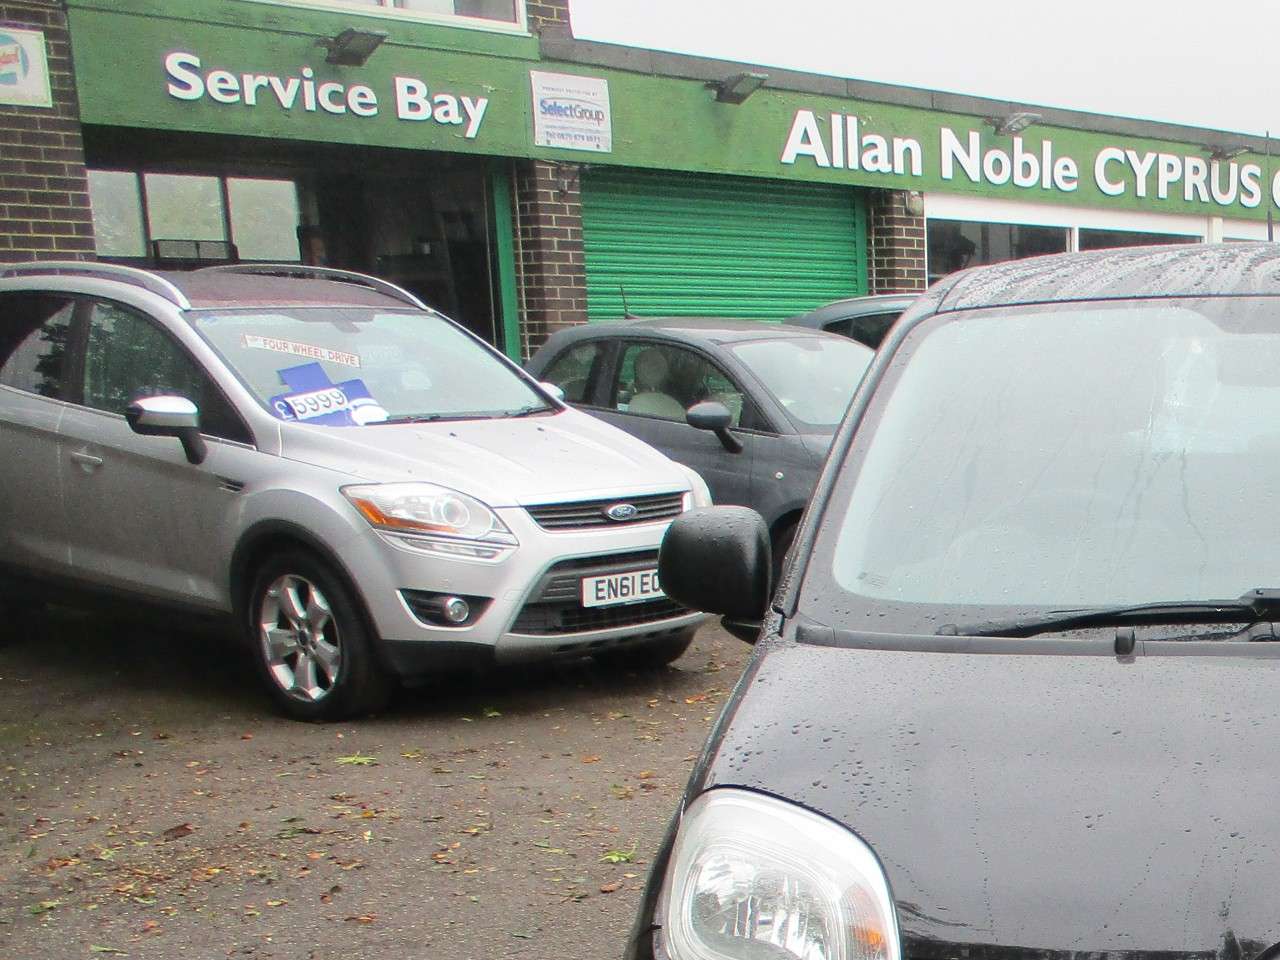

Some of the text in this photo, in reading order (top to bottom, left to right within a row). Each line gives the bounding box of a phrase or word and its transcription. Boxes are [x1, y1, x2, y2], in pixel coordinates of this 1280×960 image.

[164, 51, 489, 139] Service Bay
[540, 99, 606, 126] SelectGroup
[780, 109, 923, 177] Allan
[940, 126, 1080, 193] Noble
[1093, 147, 1263, 209] CYPRUS
[263, 338, 289, 352] FOUR
[292, 343, 326, 360] WHEEL
[327, 349, 357, 366] DRIVE
[594, 575, 635, 601] EN61
